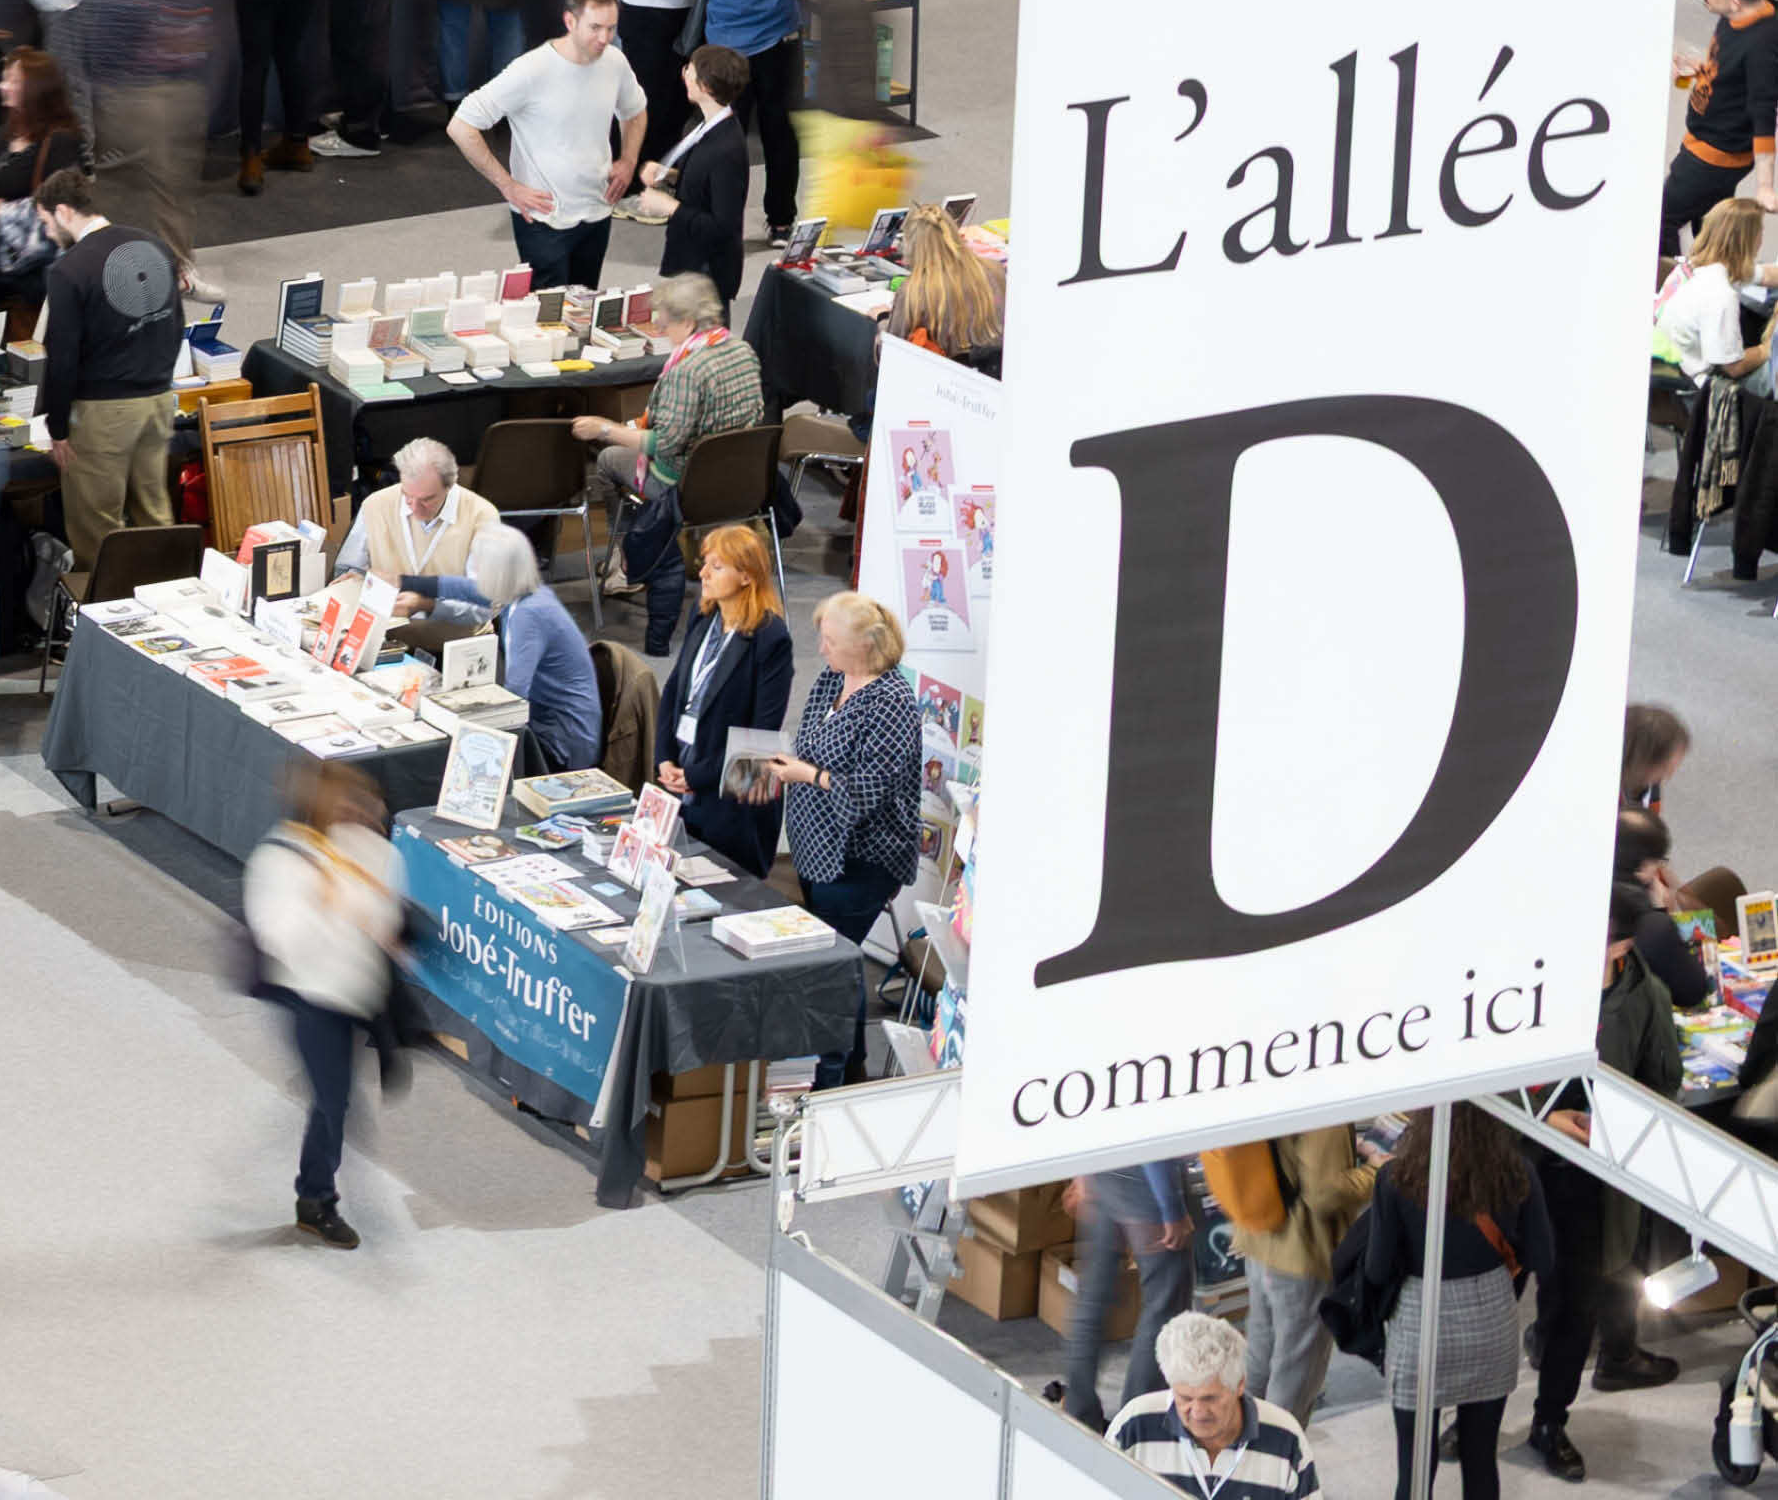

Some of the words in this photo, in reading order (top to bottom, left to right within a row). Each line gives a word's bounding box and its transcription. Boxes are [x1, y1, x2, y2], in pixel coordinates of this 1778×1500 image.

[1033, 394, 1578, 989] D
[438, 905, 597, 1042] Jobé-Truffer
[474, 894, 558, 965] EDITIONS
[1012, 1005, 1432, 1128] commence
[1461, 958, 1545, 1041] ici
